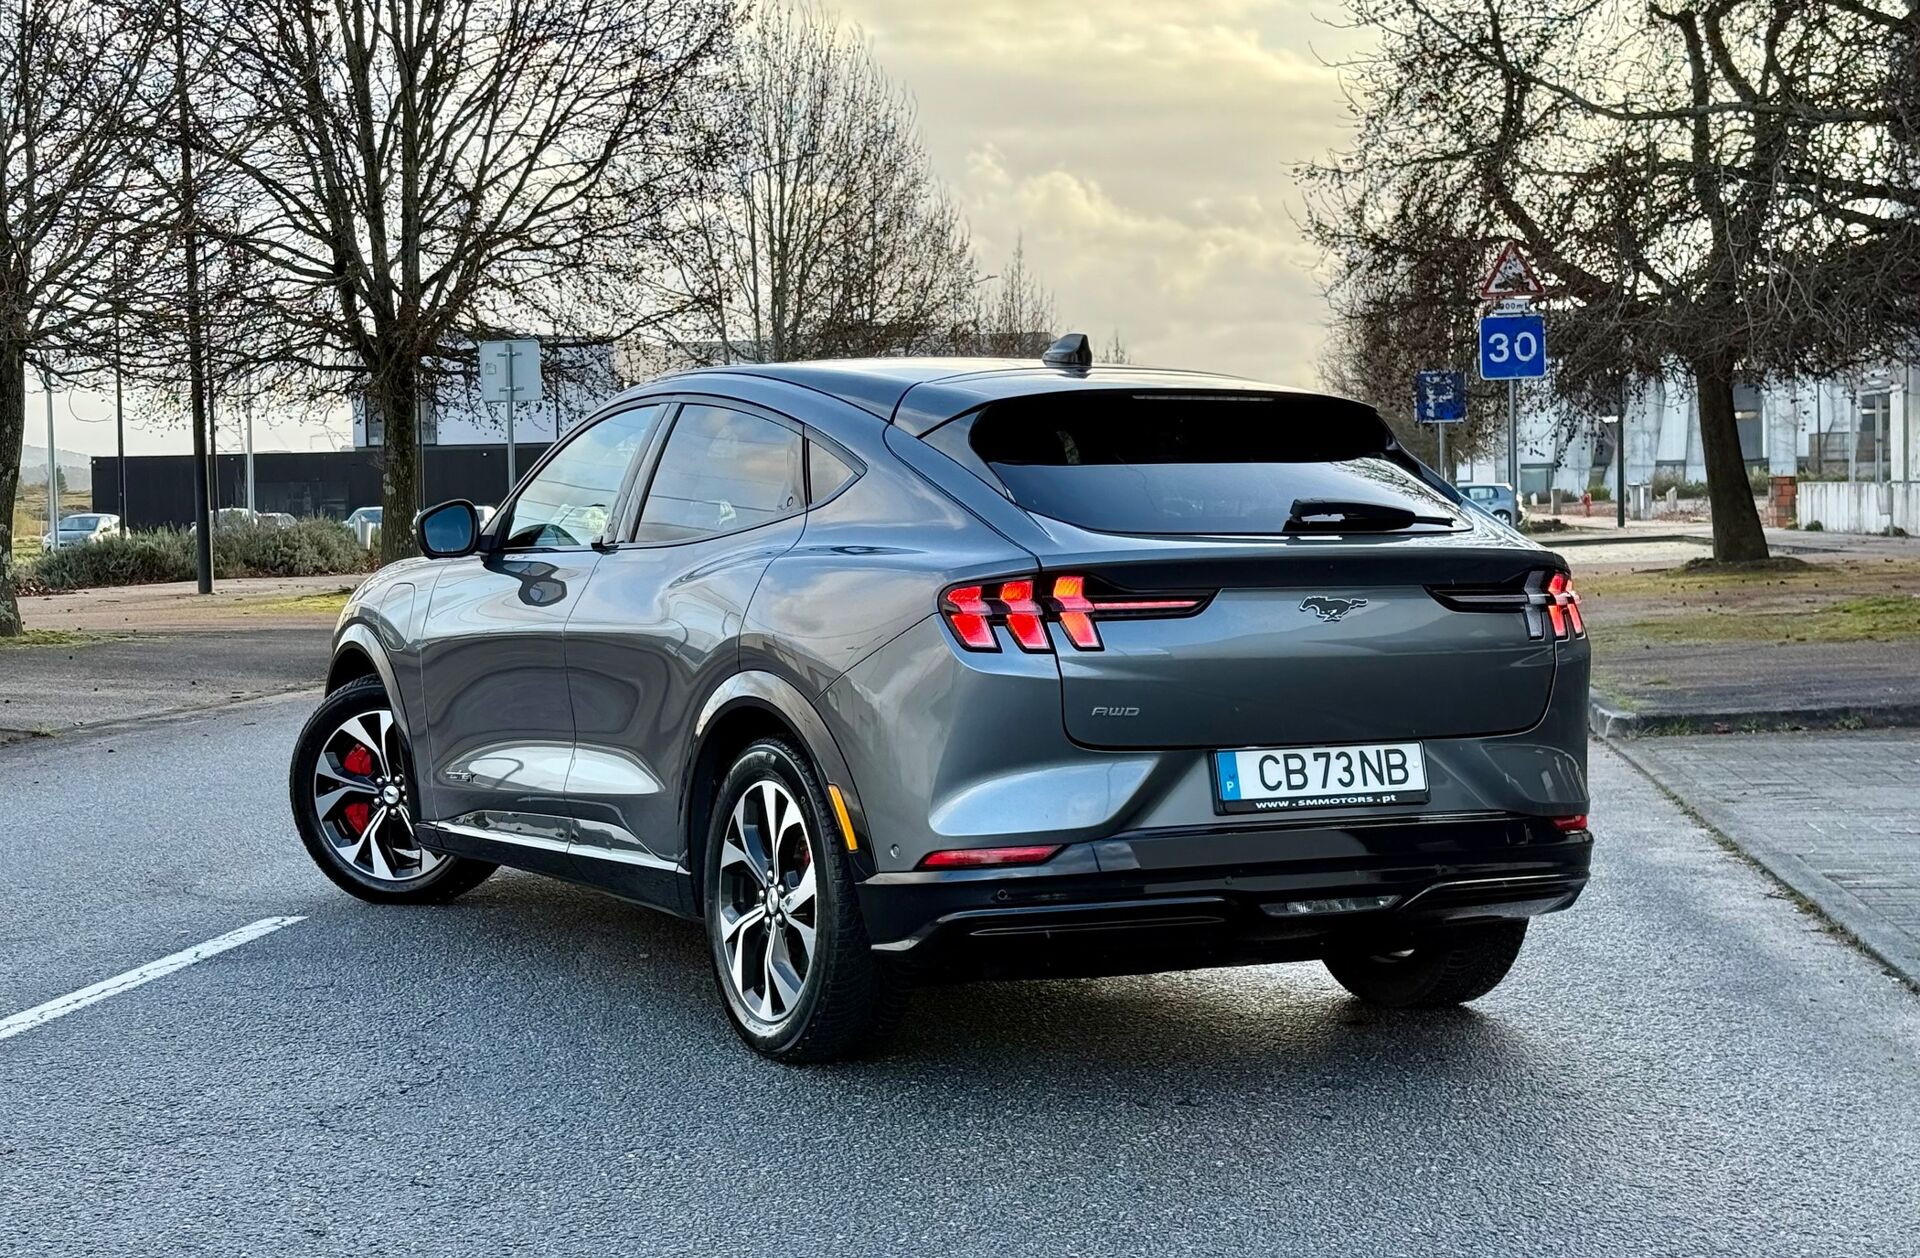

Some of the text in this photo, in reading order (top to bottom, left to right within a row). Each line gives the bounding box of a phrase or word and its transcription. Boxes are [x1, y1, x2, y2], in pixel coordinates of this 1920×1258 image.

[1488, 331, 1538, 363] 30
[1091, 706, 1141, 717] AWD
[1226, 780, 1235, 793] P
